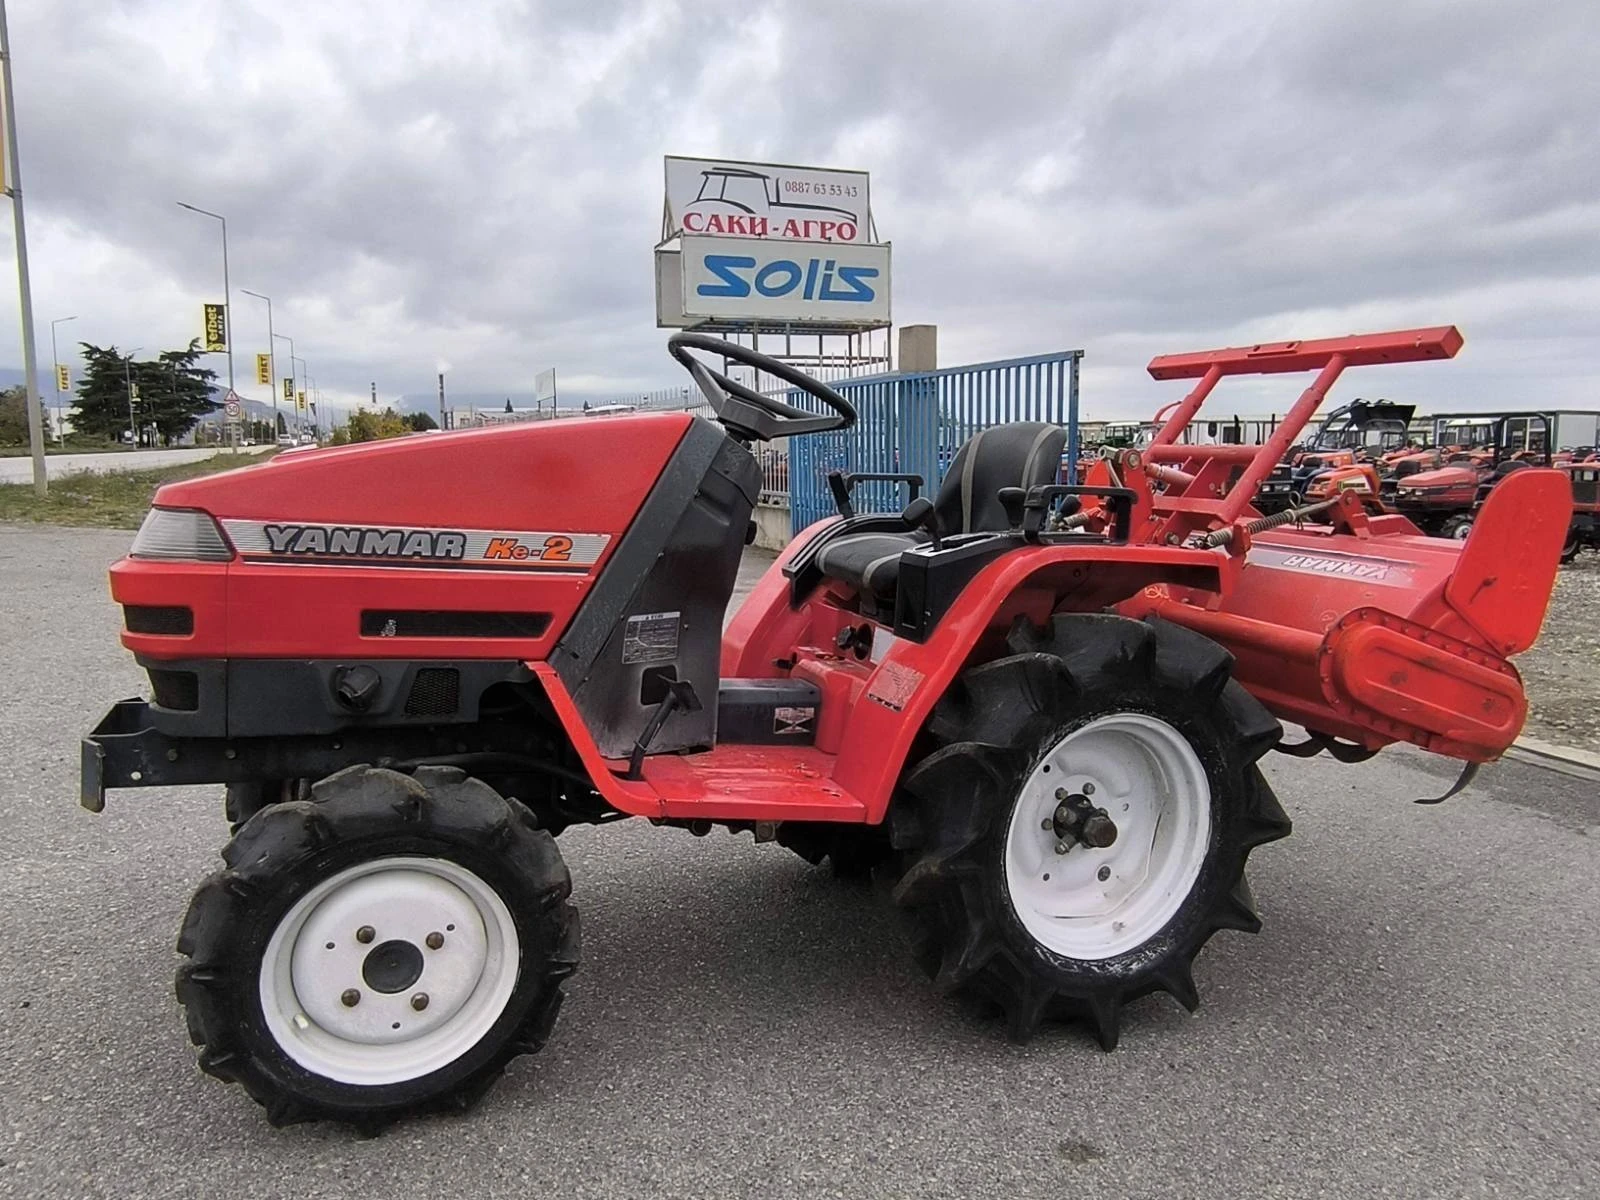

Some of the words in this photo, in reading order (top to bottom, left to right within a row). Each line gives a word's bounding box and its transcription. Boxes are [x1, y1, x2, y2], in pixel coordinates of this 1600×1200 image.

[785, 180, 810, 194] 0887
[844, 185, 858, 198] 43
[264, 525, 468, 560] YANMAR
[485, 536, 575, 562] Ke-2
[1282, 555, 1390, 580] YANMAR
